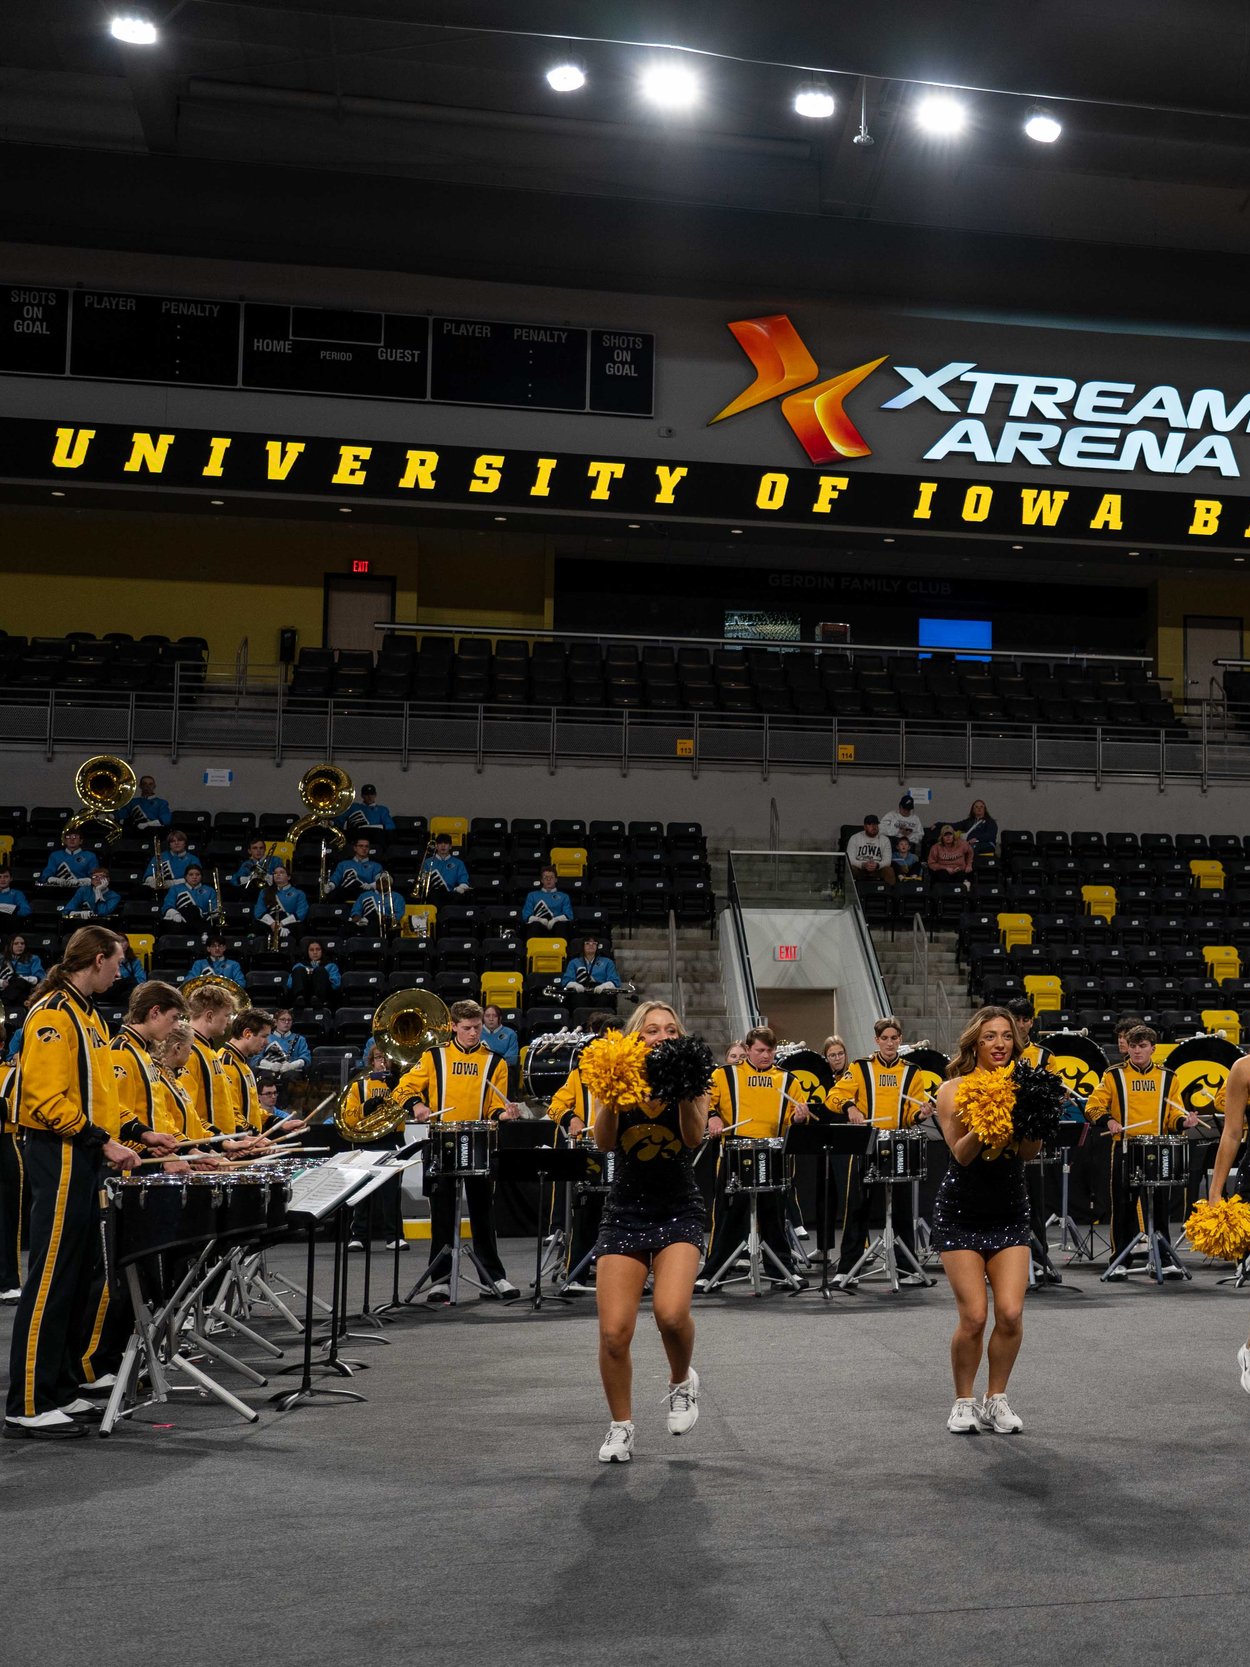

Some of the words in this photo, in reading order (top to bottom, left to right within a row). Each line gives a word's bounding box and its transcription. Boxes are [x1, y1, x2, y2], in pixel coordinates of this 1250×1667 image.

[10, 289, 57, 306] SHOTS
[23, 305, 43, 319] ON
[84, 295, 137, 311] PLAYER
[161, 301, 221, 318] PENALTY
[13, 319, 51, 335] GOAL
[443, 322, 491, 338] PLAYER
[513, 327, 568, 344] PENALTY
[602, 334, 643, 350] SHOTS
[253, 338, 293, 354] HOME
[377, 347, 421, 363] GUEST
[320, 350, 353, 361] PERIOD
[614, 349, 632, 362] ON
[605, 362, 638, 377] GOAL
[922, 419, 1242, 477] ARENA
[51, 427, 689, 504] UNIVERSITY
[755, 472, 849, 513] OF
[912, 482, 1123, 531] IOWA
[352, 560, 369, 573] EXIT
[768, 573, 835, 590] GERDIN
[840, 576, 901, 593] FAMILY
[906, 580, 952, 596] CLUB
[857, 845, 882, 857] IOWA
[779, 944, 798, 961] EXIT
[452, 1061, 479, 1076] IOWA
[748, 1075, 773, 1088] IOWA
[879, 1073, 898, 1087] IOWA
[1132, 1079, 1156, 1092] IOWA
[461, 1142, 469, 1167] YAMAHA
[758, 1159, 767, 1184] YAMAHA
